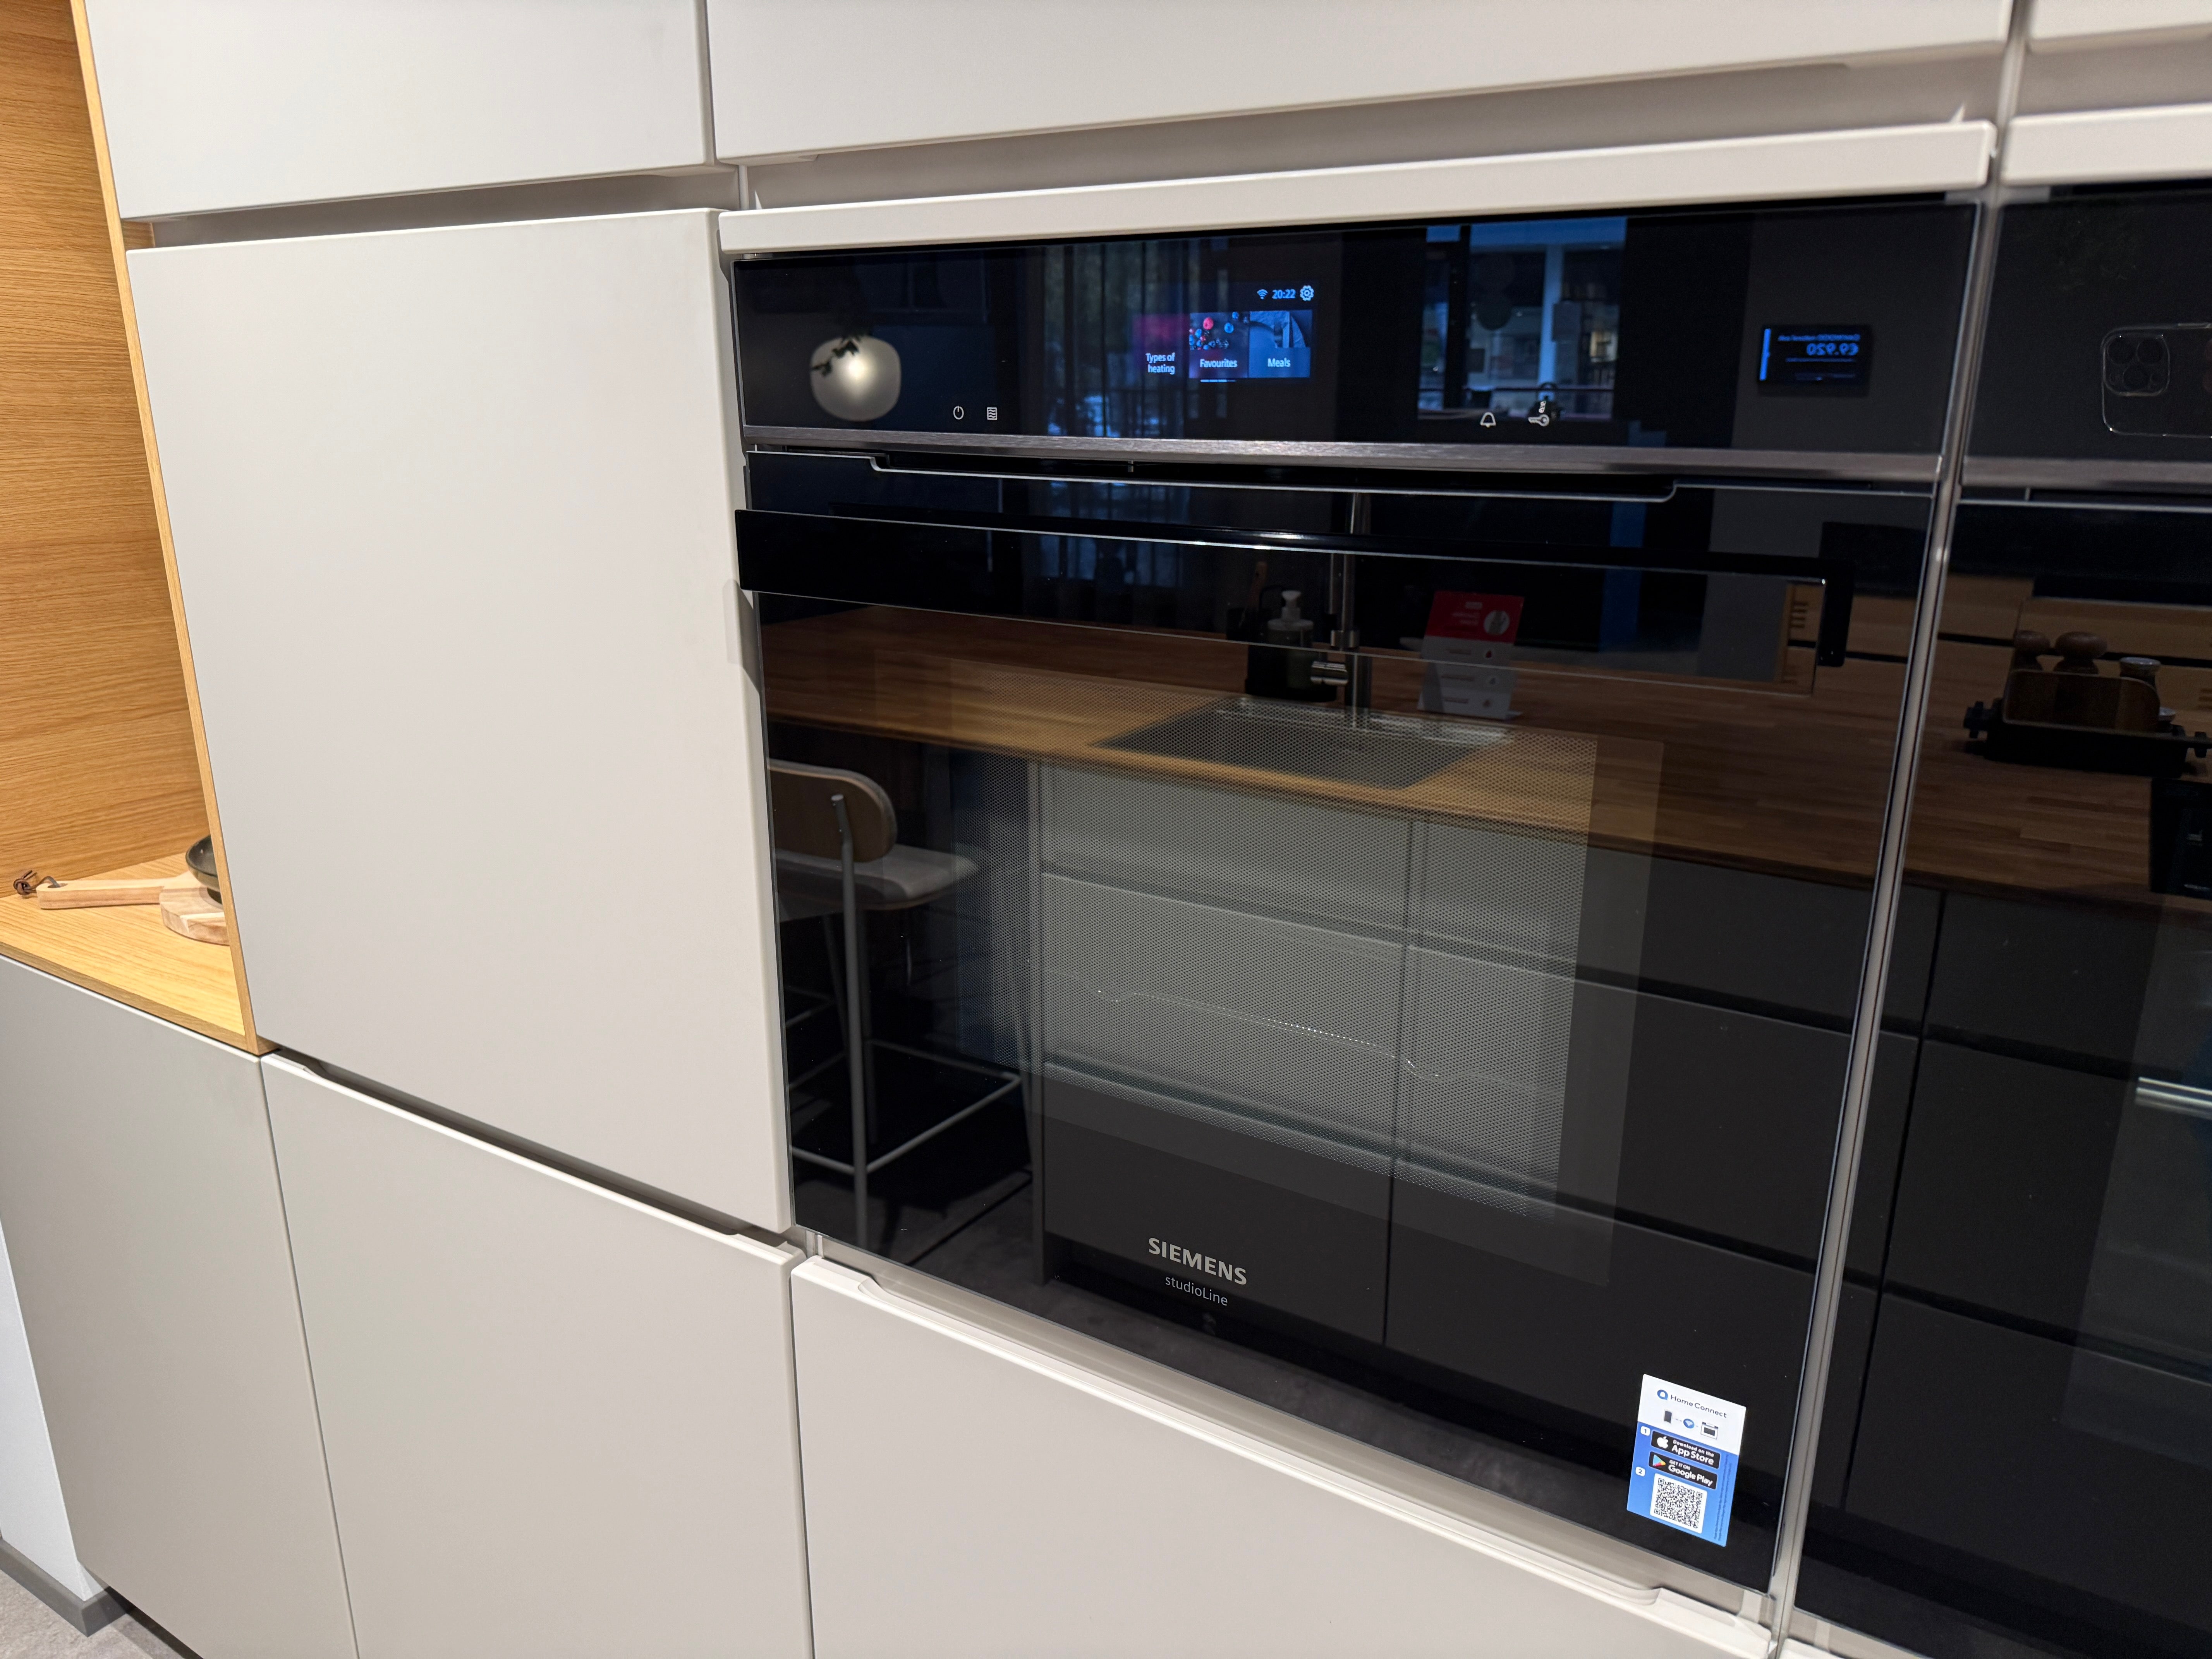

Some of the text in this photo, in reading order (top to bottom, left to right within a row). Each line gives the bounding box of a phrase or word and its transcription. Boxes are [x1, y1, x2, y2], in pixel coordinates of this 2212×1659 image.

[1272, 289, 1296, 299] 20:22
[1146, 352, 1175, 363] Types of
[1200, 359, 1238, 368] Favourites
[1267, 358, 1291, 368] Meals
[1147, 364, 1175, 375] heating
[1148, 1238, 1247, 1285] SIEMENS
[1165, 1276, 1228, 1306] studioLine
[1671, 1395, 1727, 1418] Home Connect
[1673, 1439, 1697, 1451] Download
[1671, 1445, 1714, 1465] App Store
[1668, 1464, 1713, 1487] Google Play
